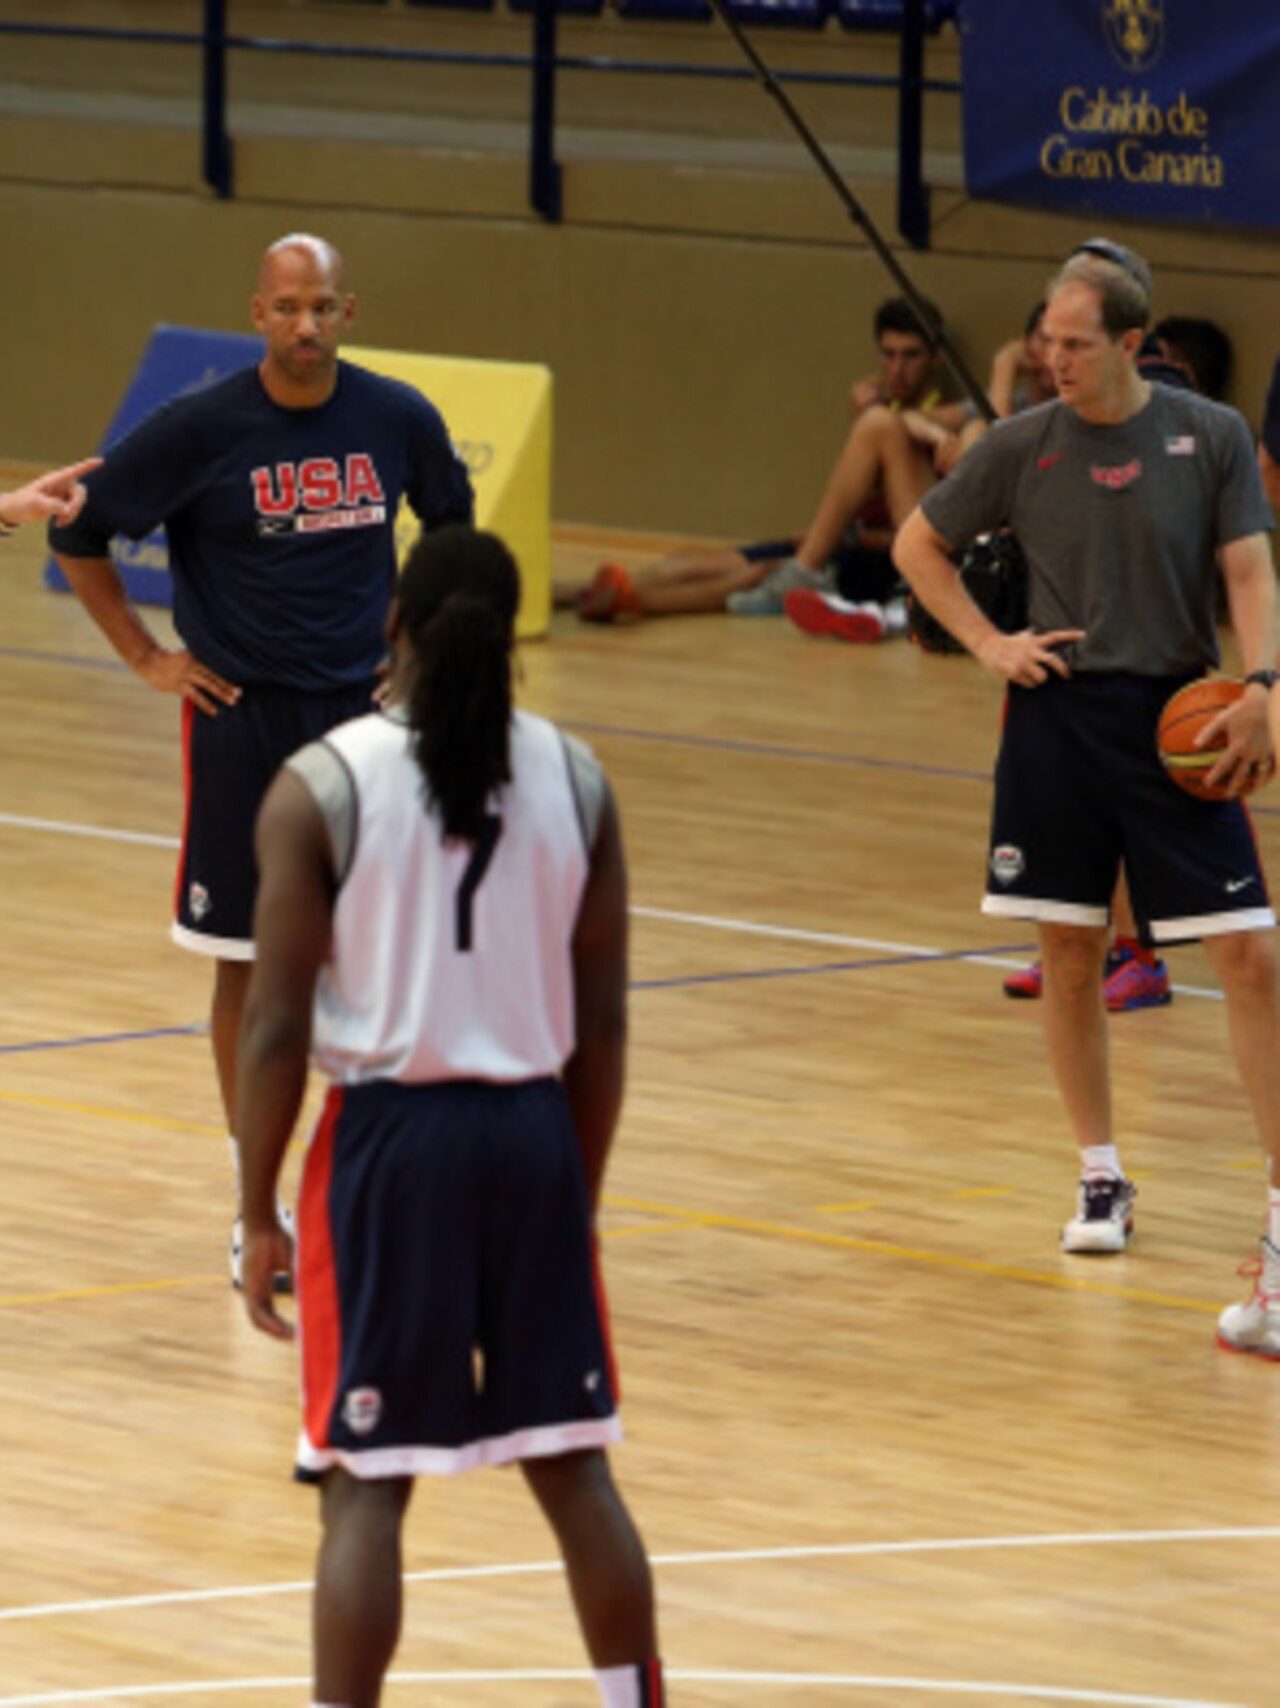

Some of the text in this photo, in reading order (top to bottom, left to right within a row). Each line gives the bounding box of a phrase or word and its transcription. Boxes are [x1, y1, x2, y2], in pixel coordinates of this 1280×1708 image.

[1059, 86, 1209, 137] Cabildo de
[1040, 133, 1224, 188] Gran Canaria
[250, 452, 385, 517] USA
[454, 808, 503, 953] 7
